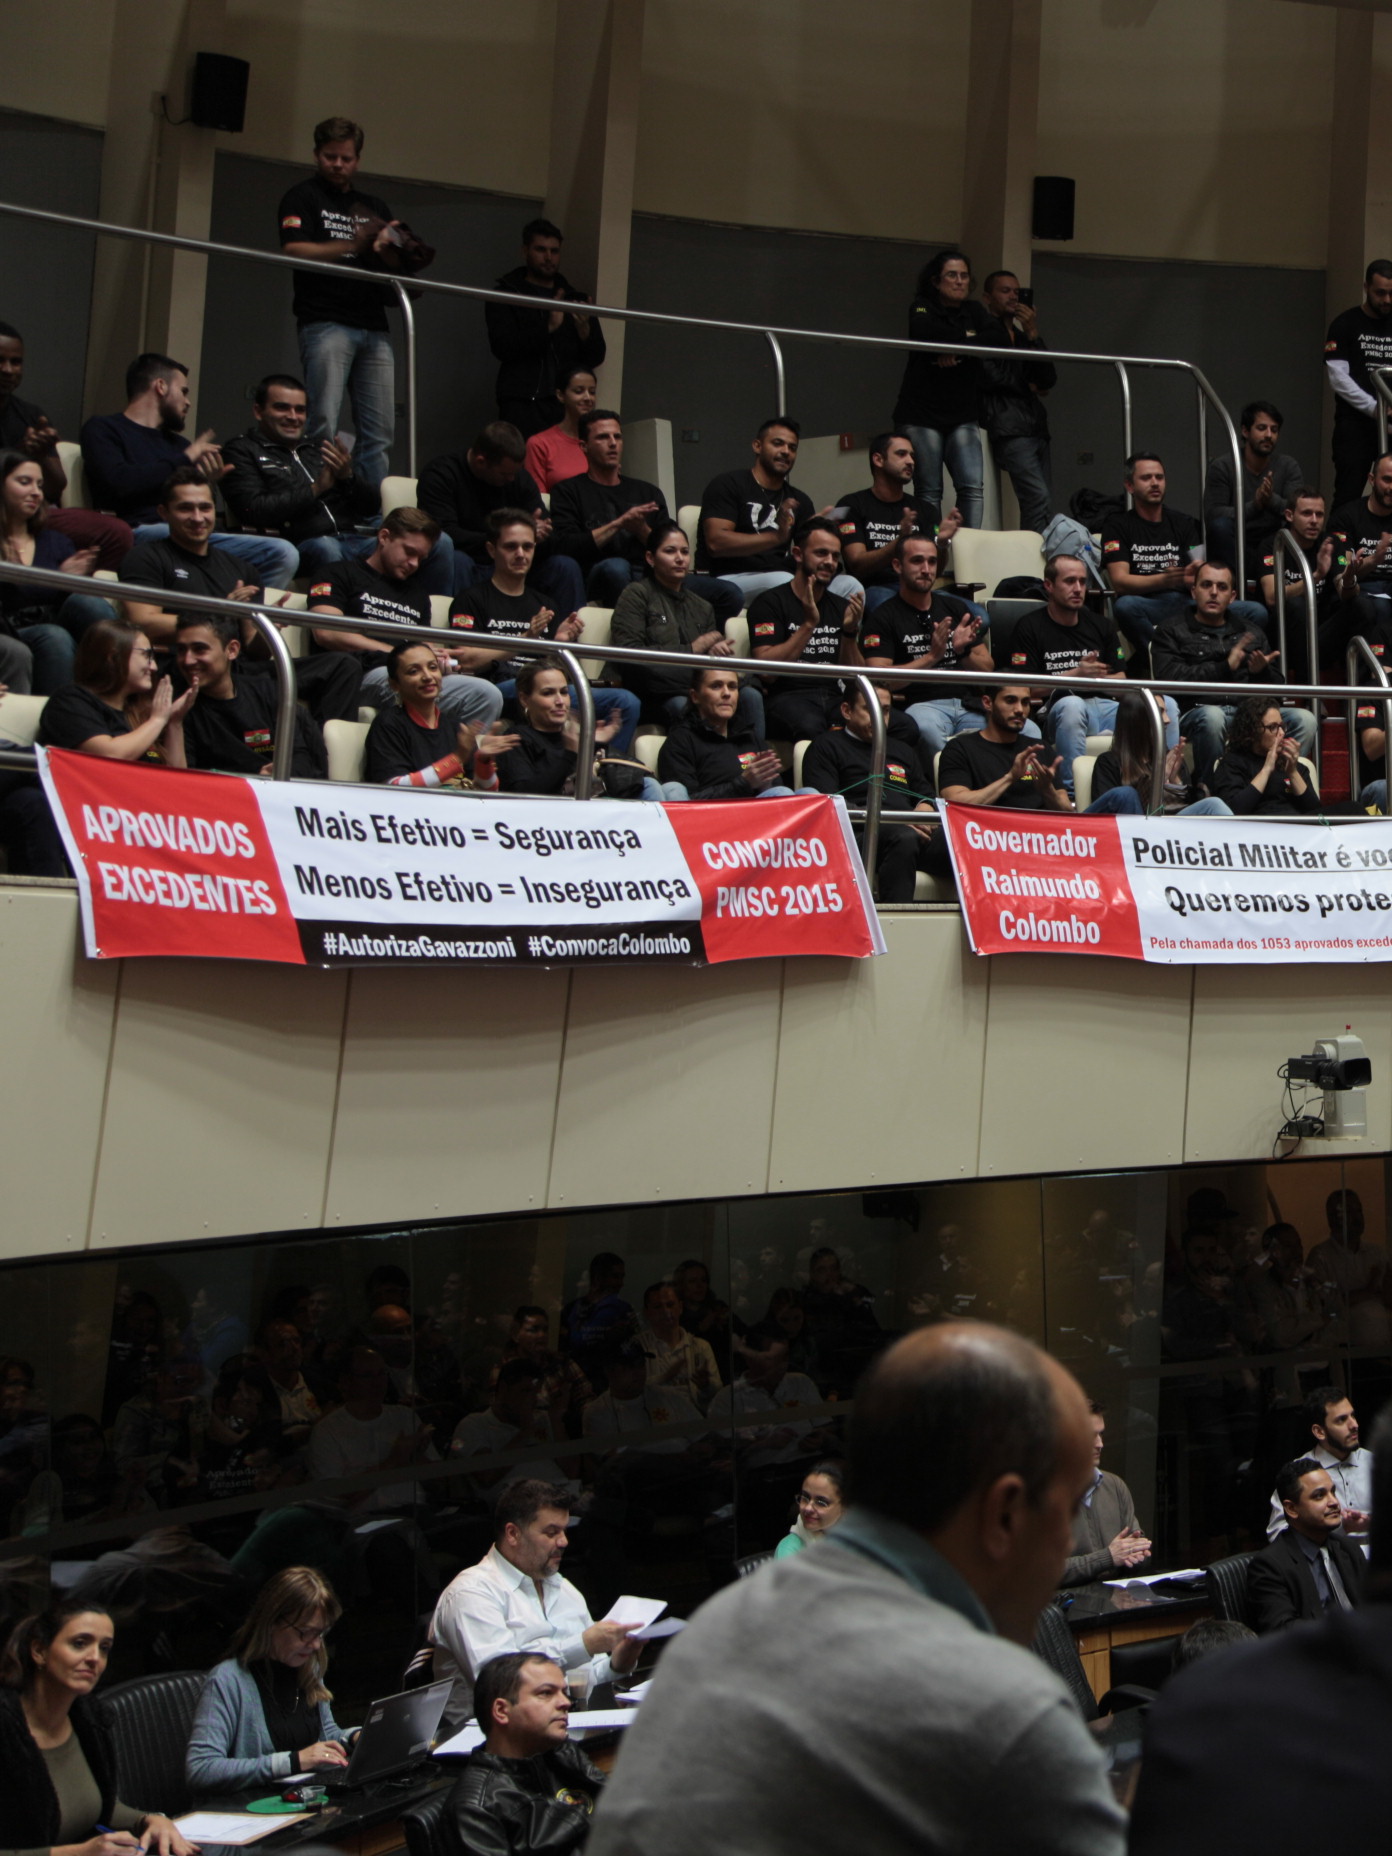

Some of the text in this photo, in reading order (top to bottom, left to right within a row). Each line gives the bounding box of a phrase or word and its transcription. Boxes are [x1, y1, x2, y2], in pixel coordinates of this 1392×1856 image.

[1365, 350, 1383, 358] PMSC
[1133, 553, 1180, 562] Excedentes
[360, 592, 421, 619] Aprovados
[83, 805, 255, 858] APROVADOS
[295, 807, 641, 857] Mais Efetivo = Segurança
[966, 822, 1096, 857] Governador
[703, 837, 827, 869] CONCURSO
[1132, 838, 1234, 871] Policial
[1238, 844, 1327, 868] Militar
[1336, 841, 1351, 868] é
[98, 862, 277, 915] EXCEDENTES
[294, 865, 691, 908] Menos Efetivo = Insegurança
[982, 866, 1101, 899] Raimundo
[717, 883, 842, 917] PMSC 2015
[1165, 886, 1310, 917] Queremos
[1000, 910, 1100, 943] Colombo
[324, 933, 690, 961] #AutorizaGavazzoni #ConvocaColombo
[1150, 937, 1176, 948] Pela
[1180, 938, 1233, 949] chamada
[1237, 938, 1257, 949] dos
[1261, 938, 1291, 949] 1053
[1295, 937, 1353, 951] aprovados
